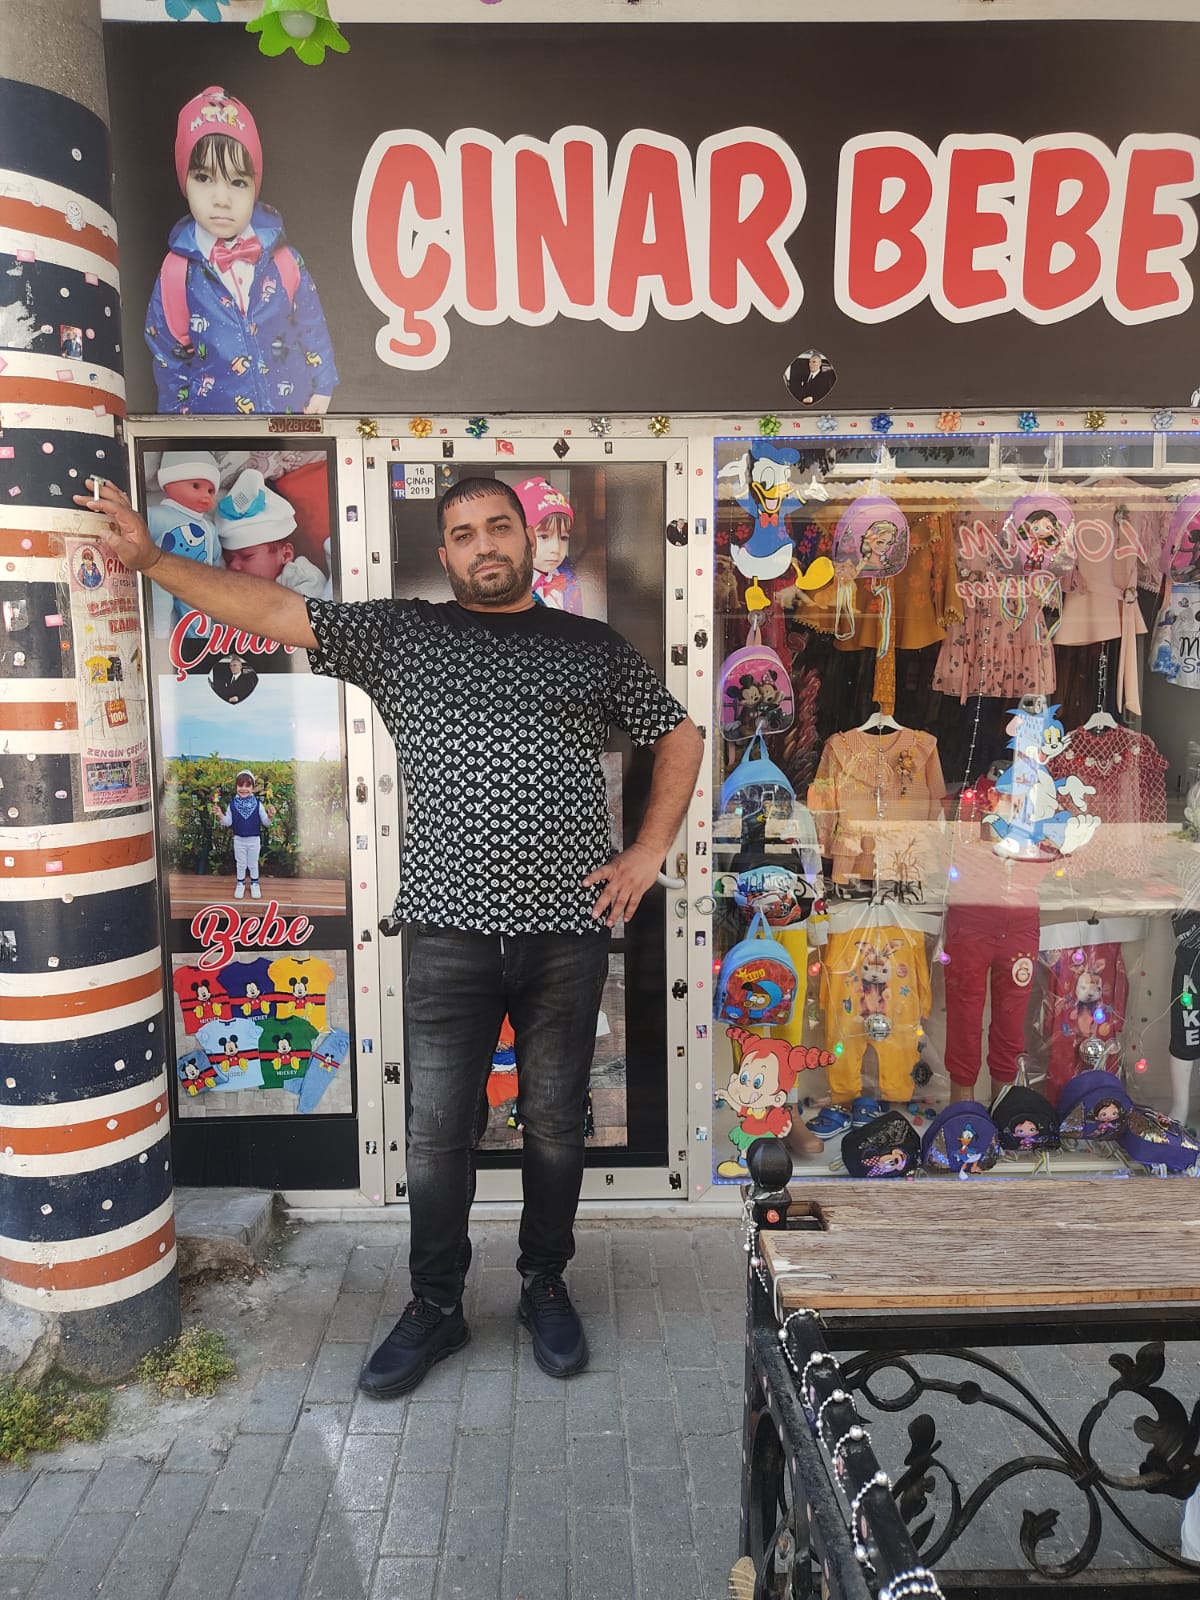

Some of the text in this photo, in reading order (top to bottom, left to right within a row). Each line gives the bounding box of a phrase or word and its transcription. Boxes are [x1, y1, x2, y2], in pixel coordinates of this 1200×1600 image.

[359, 132, 1199, 364] ÇINAR BEBE
[393, 489, 405, 498] TR
[406, 477, 434, 486] ÇINAR
[106, 558, 134, 577] ÇIN
[169, 610, 298, 682] Çına
[191, 900, 313, 971] Bebe
